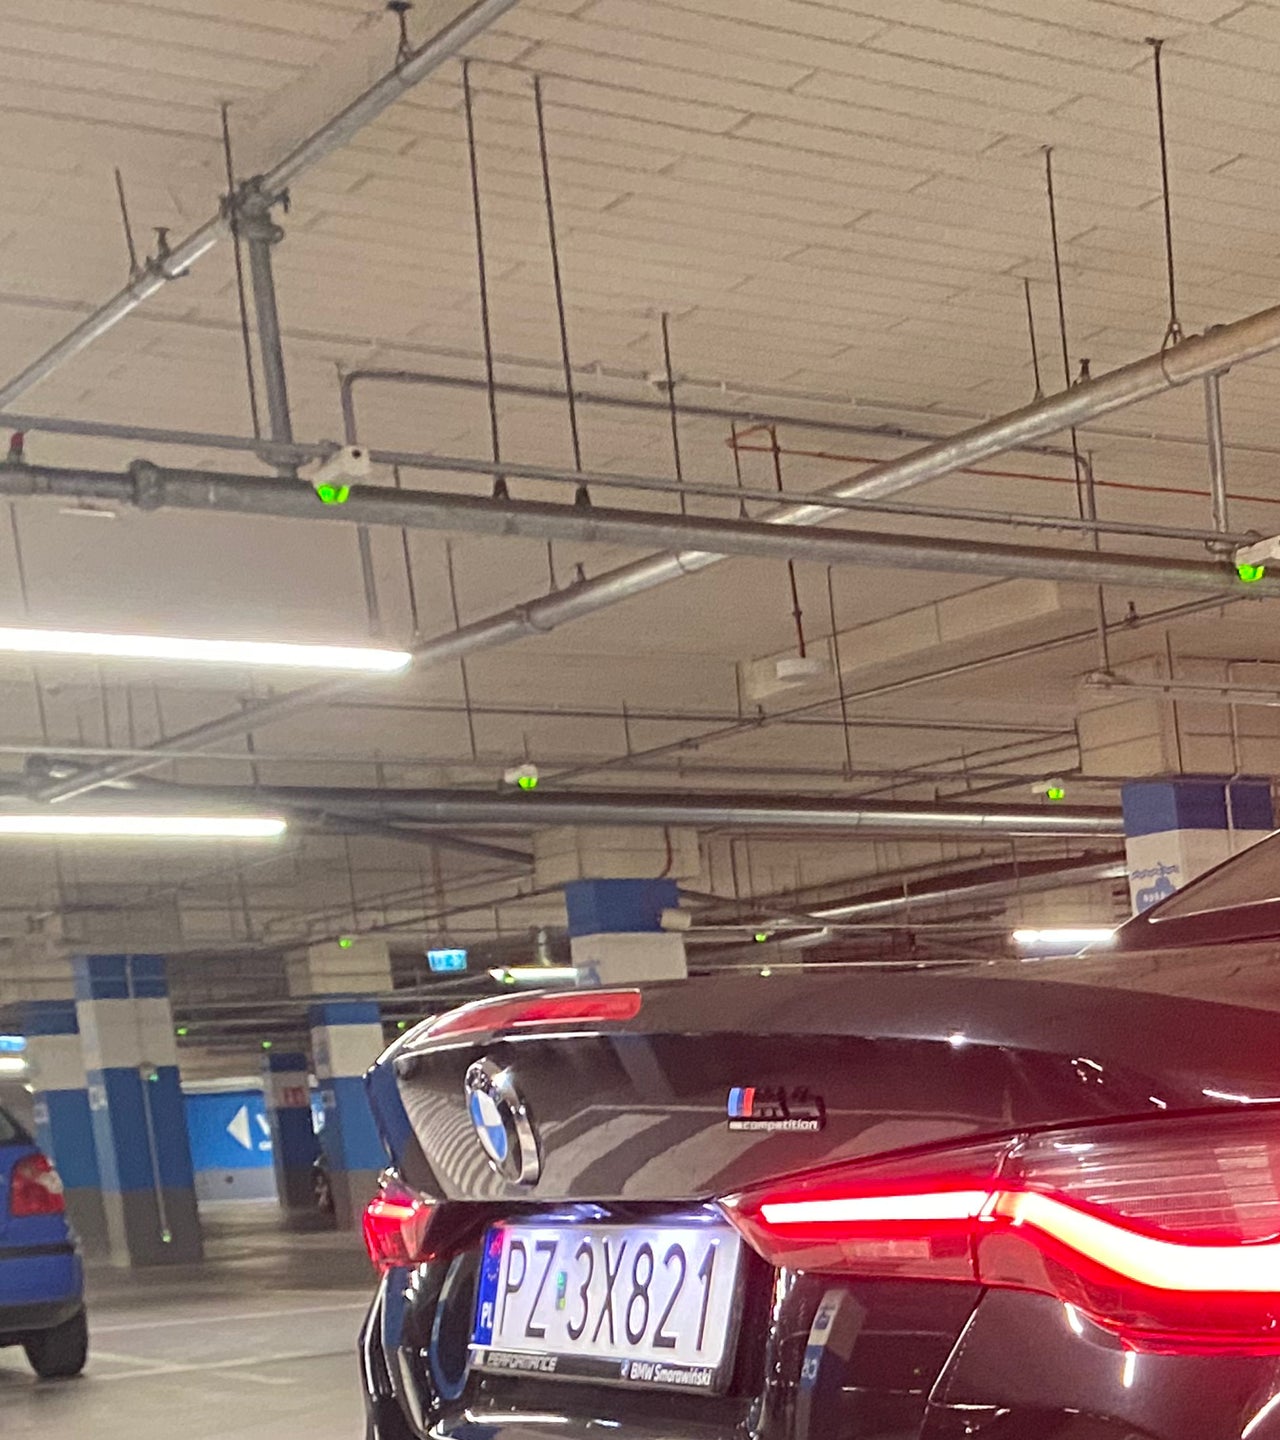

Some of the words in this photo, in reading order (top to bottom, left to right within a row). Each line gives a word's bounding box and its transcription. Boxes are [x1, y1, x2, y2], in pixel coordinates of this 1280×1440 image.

[499, 1239, 557, 1338] PZ
[566, 1237, 720, 1352] 3X821
[480, 1302, 493, 1328] PL
[630, 1362, 653, 1380] BMW
